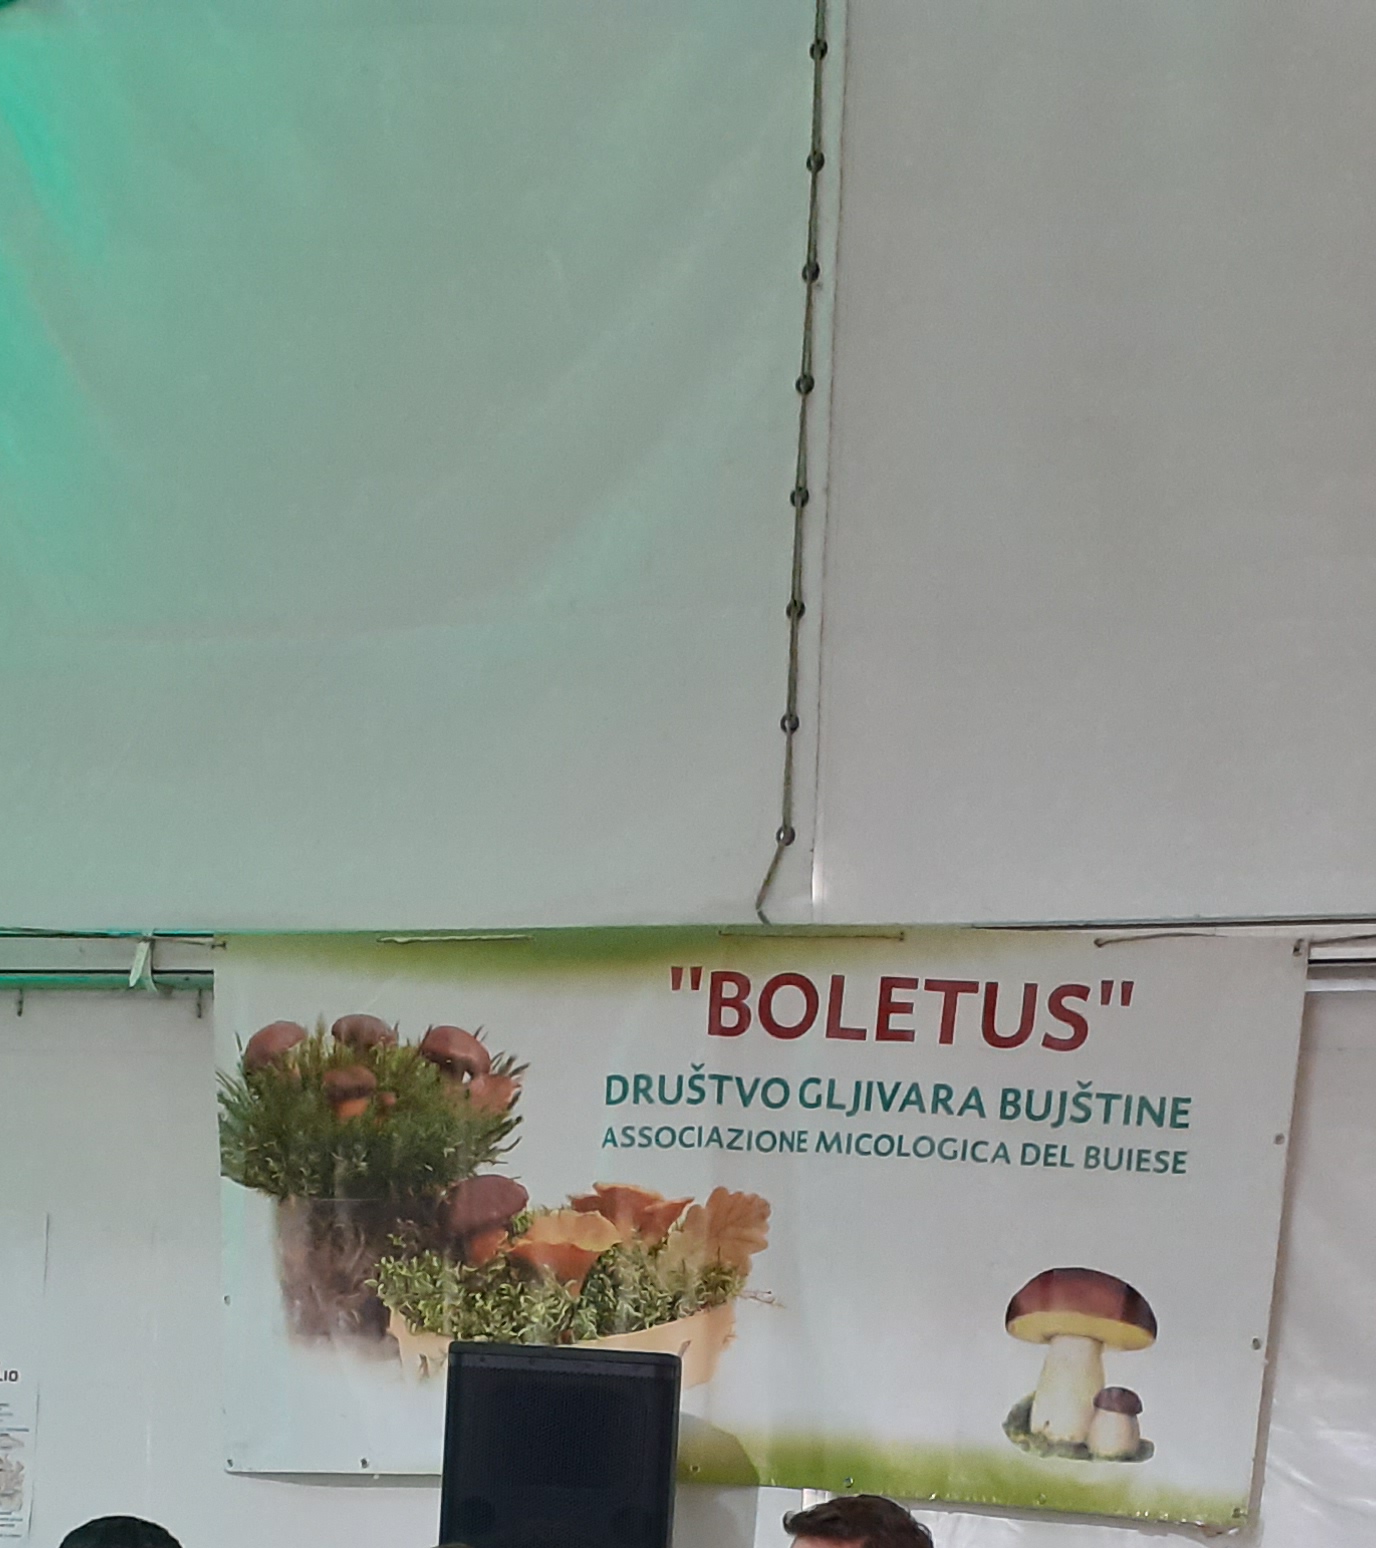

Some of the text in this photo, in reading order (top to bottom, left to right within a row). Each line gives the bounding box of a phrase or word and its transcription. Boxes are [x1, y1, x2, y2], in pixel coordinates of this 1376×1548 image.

[671, 966, 1134, 1051] "BOLETUS"
[605, 1062, 1192, 1128] DRUŠTVO GLJIVARA BUJŠTINE
[601, 1125, 1188, 1174] ASSOCIAZIONE MICOLOGICA DEL BUIESE
